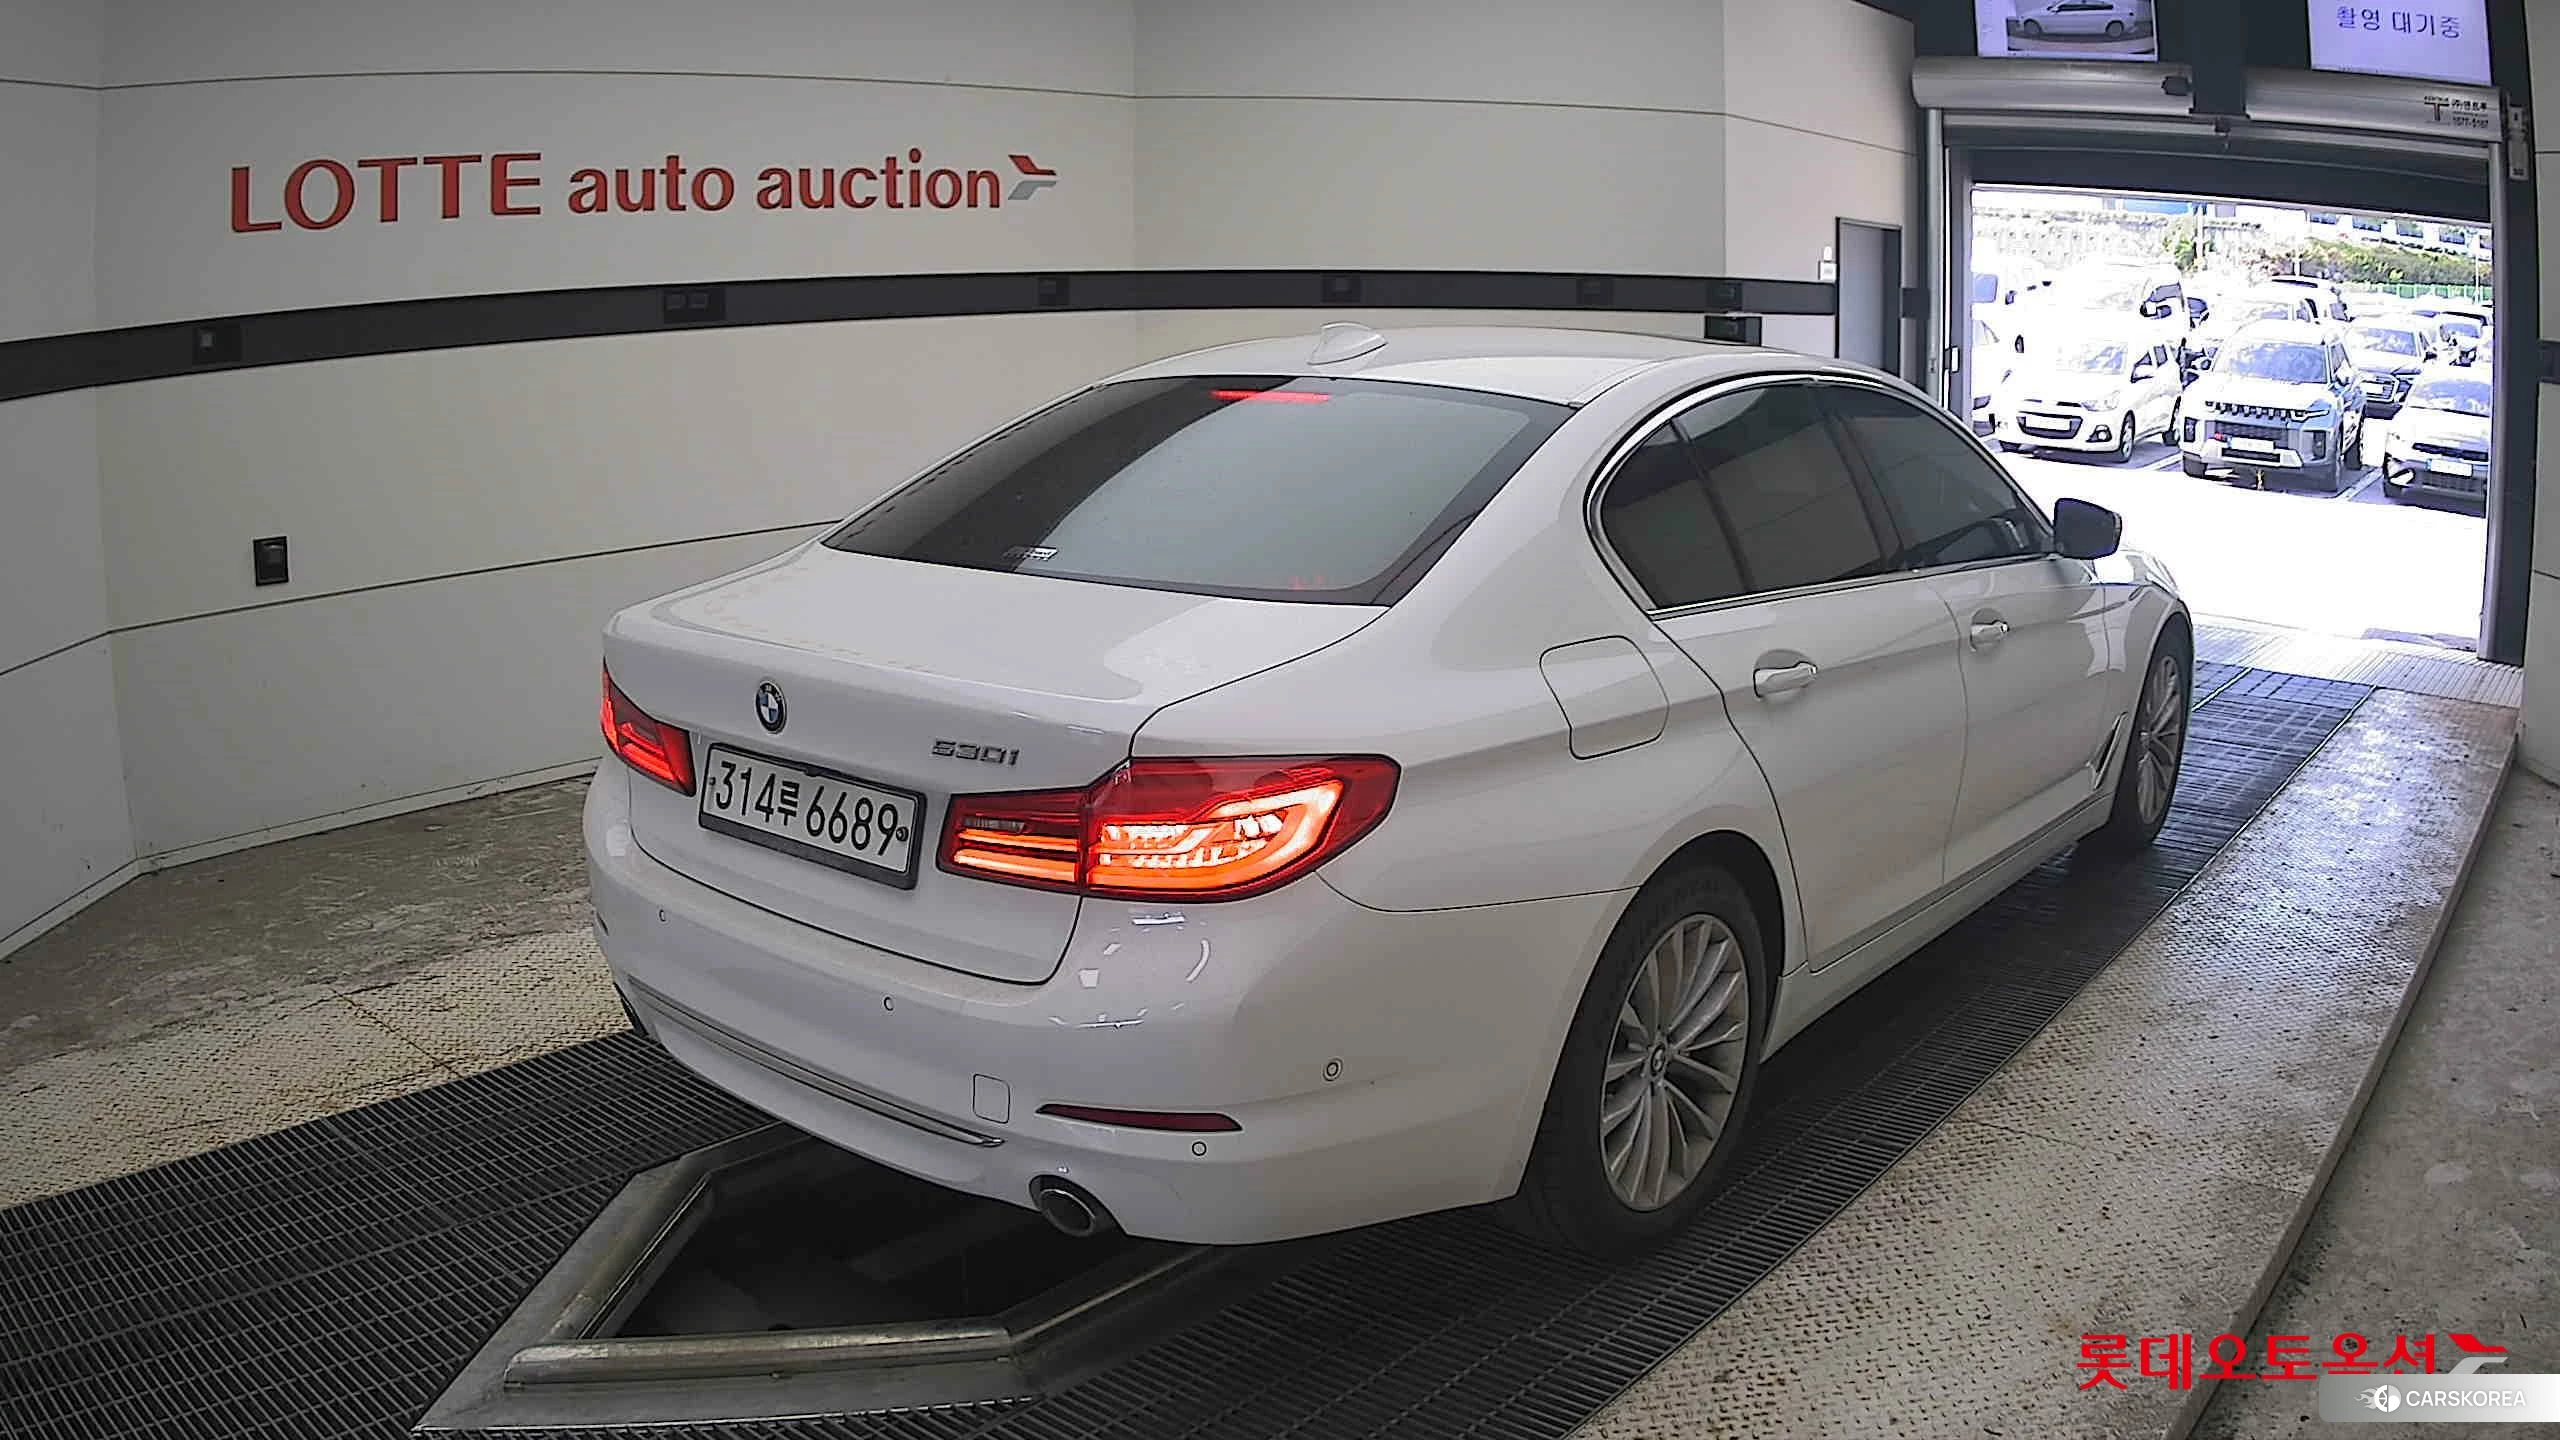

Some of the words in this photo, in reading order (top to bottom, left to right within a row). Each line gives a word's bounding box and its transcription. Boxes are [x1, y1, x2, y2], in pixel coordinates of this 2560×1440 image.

[2336, 5, 2380, 31] 촬영
[2392, 11, 2461, 39] 대기중
[230, 152, 543, 233] LOTTE
[568, 153, 735, 214] auto
[756, 147, 1001, 211] auction
[931, 740, 1020, 766] 530i
